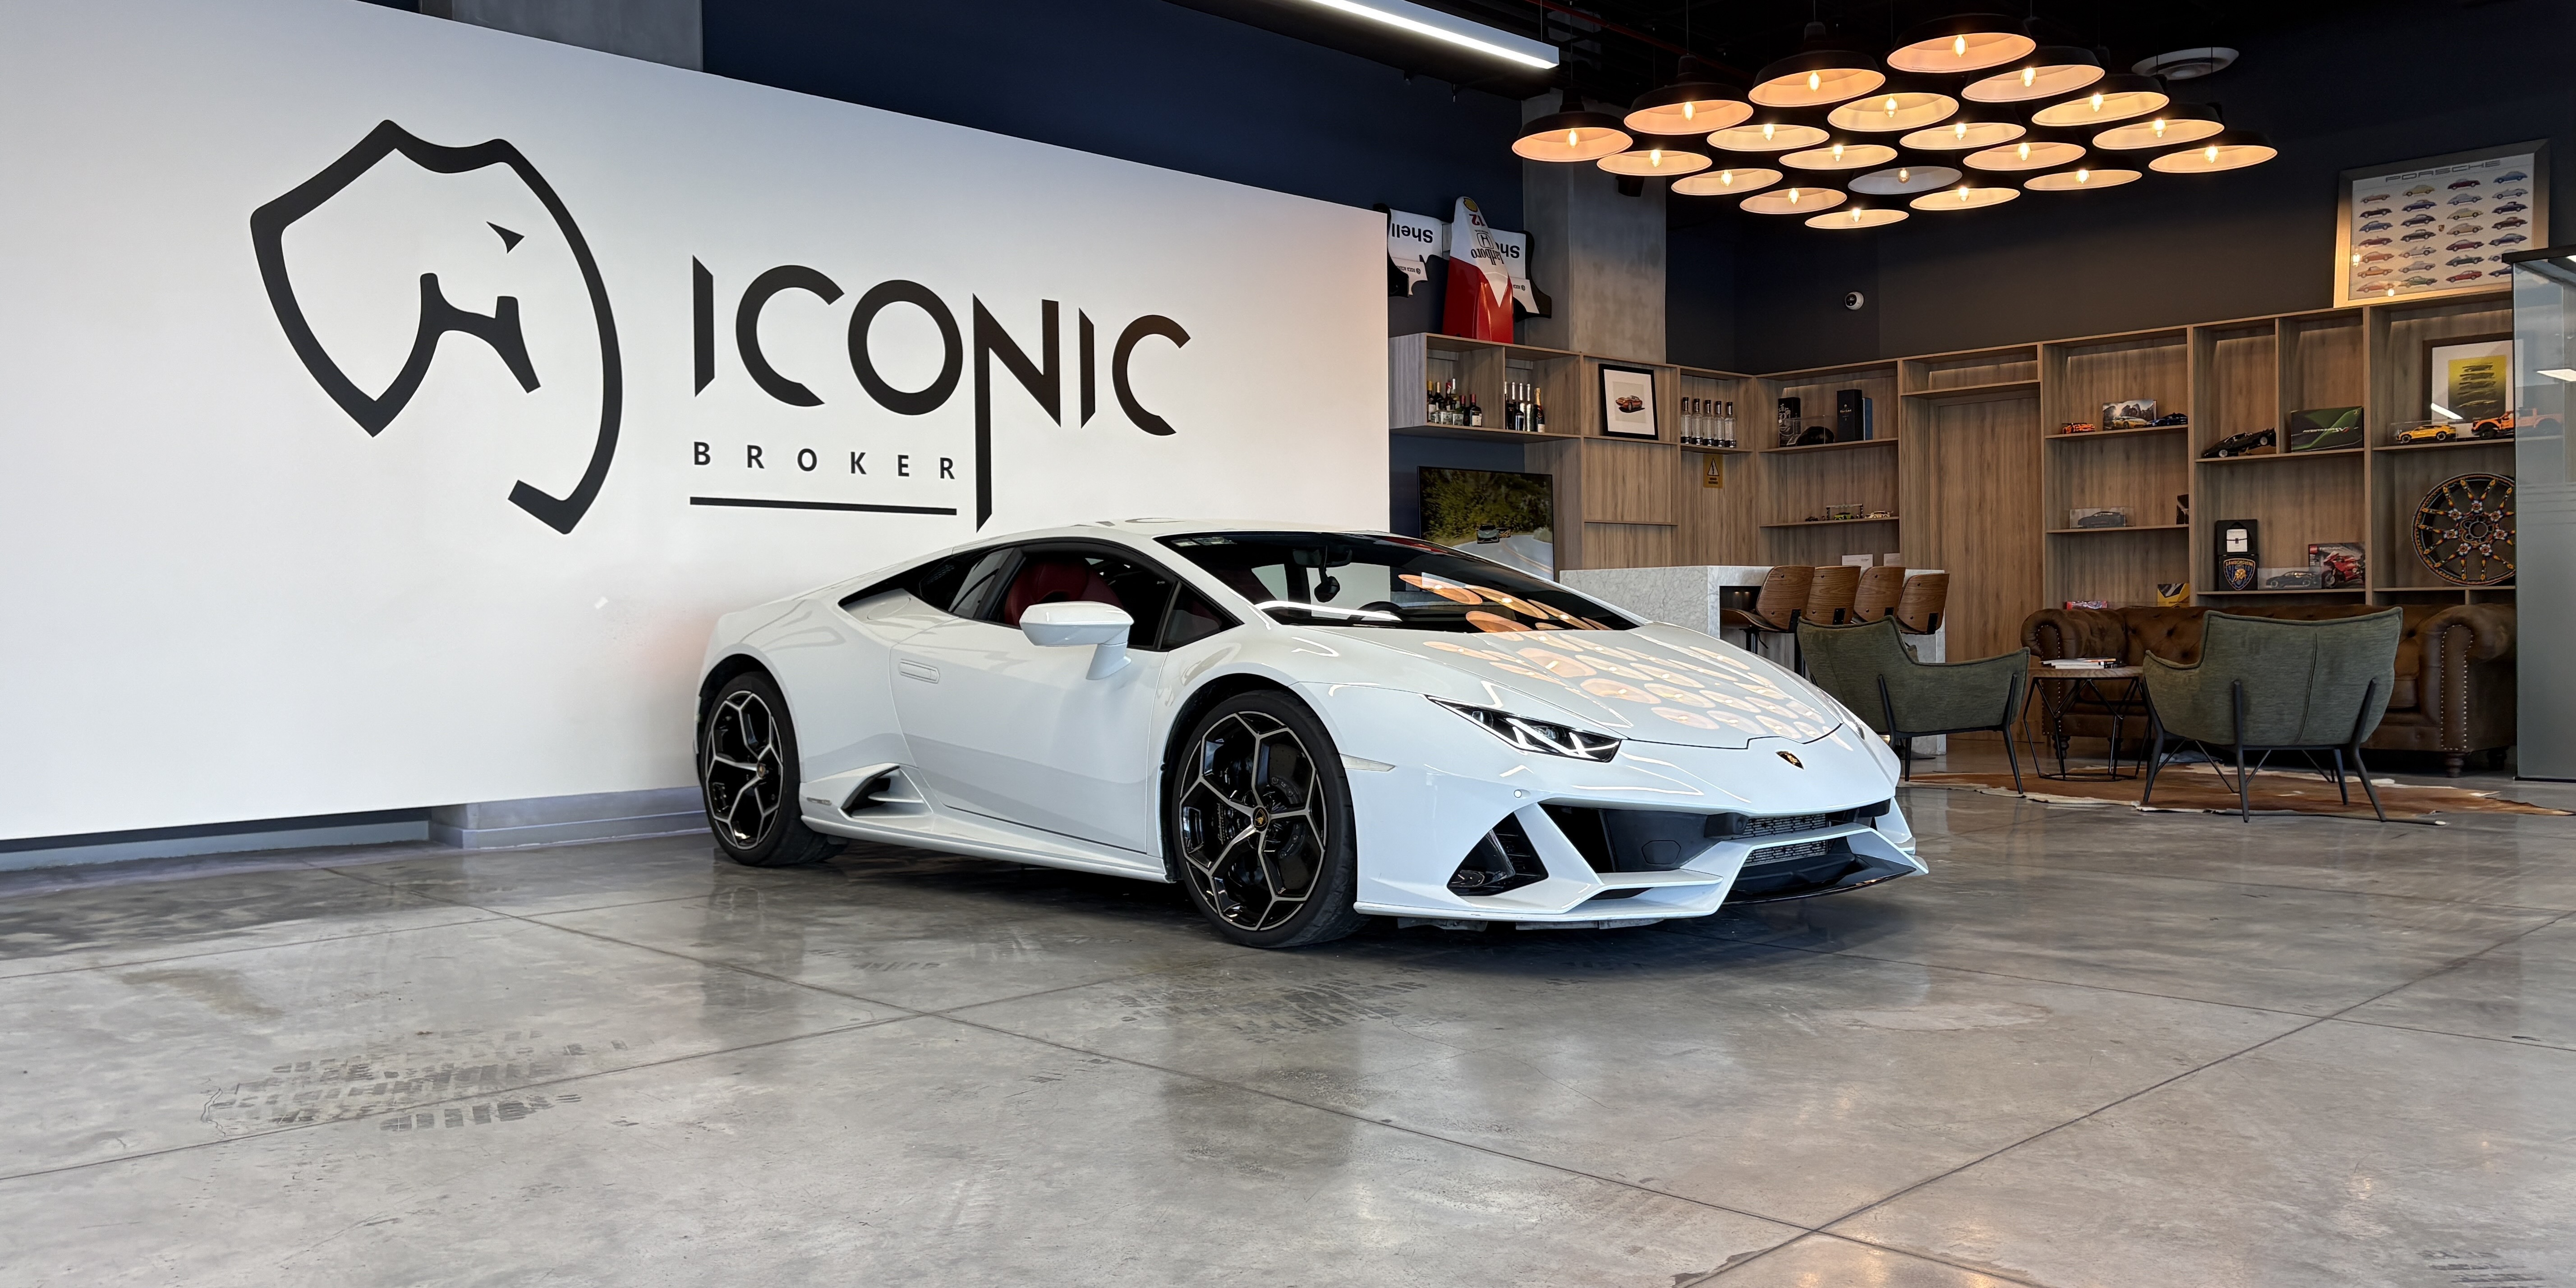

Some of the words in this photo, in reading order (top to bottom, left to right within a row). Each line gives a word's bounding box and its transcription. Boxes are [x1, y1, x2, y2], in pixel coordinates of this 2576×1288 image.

[2386, 160, 2501, 182] PORSCHE
[1469, 214, 1485, 226] 12
[1392, 223, 1433, 243] Shell
[692, 255, 1191, 533] ICONIC
[693, 442, 956, 479] BROKER
